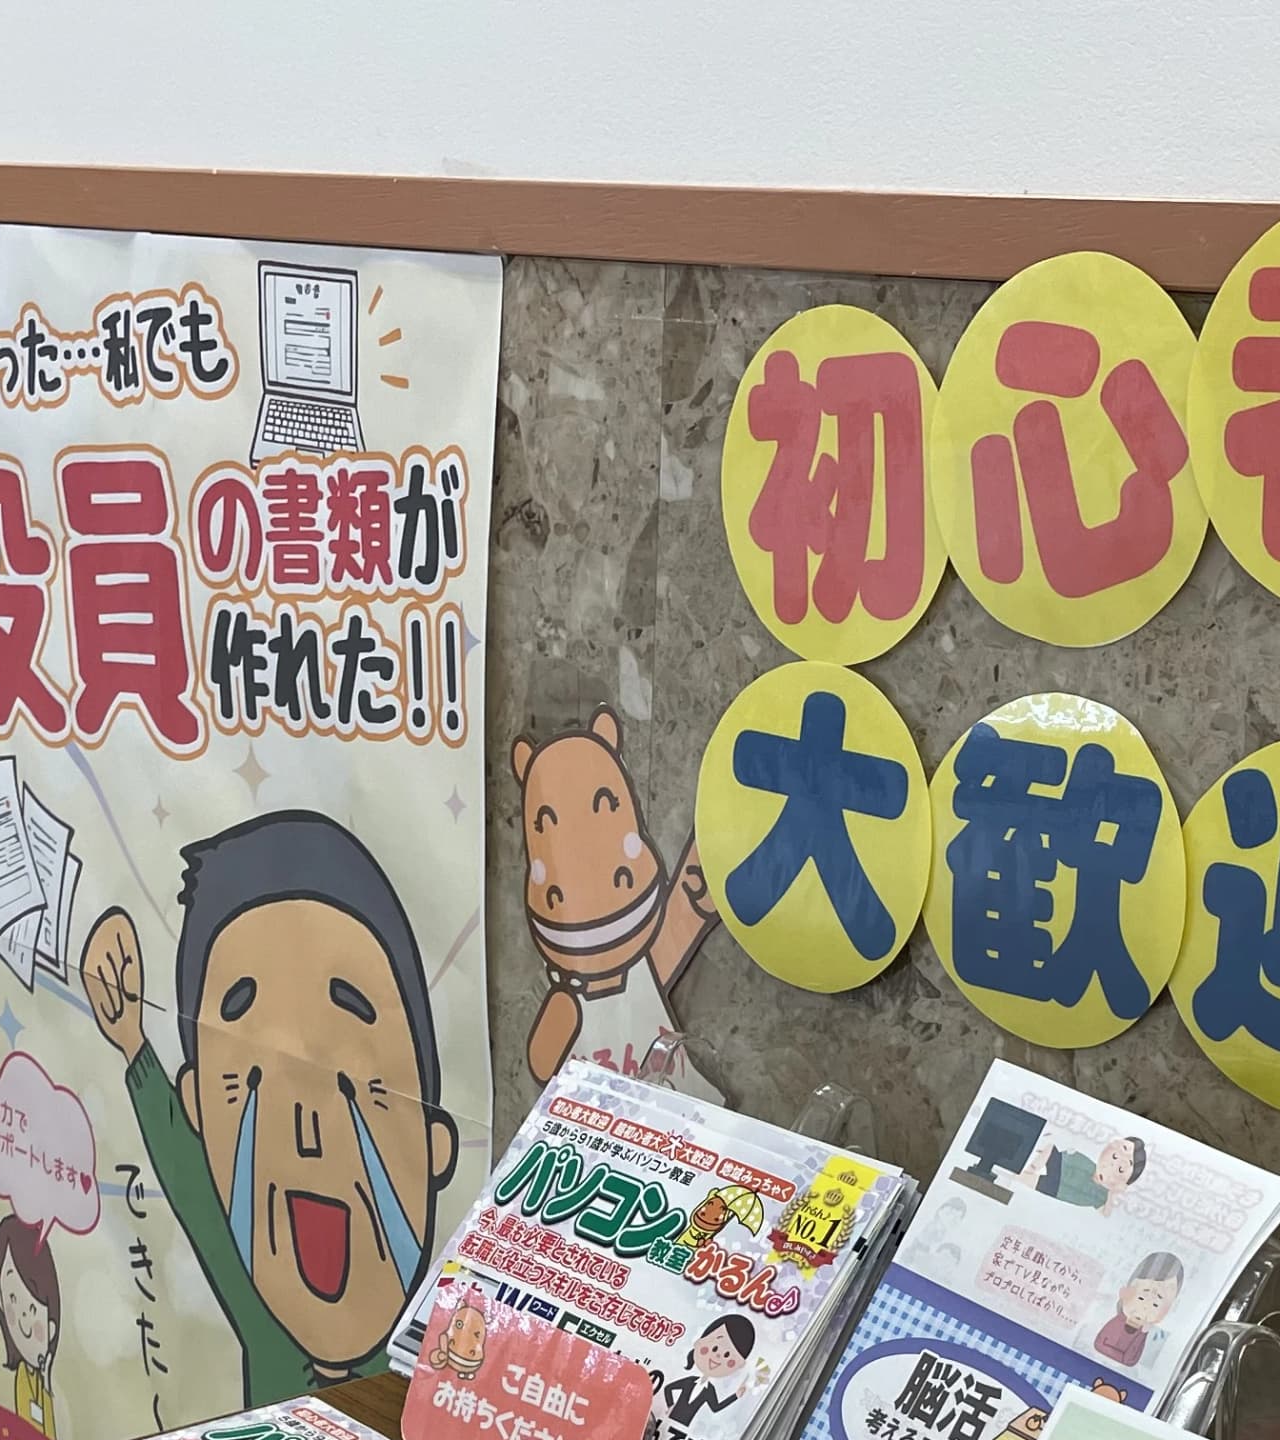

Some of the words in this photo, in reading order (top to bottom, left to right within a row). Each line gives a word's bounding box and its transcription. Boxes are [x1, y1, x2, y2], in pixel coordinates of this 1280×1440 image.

[496, 1144, 687, 1256] パソコン
[648, 1240, 691, 1274] 教室
[531, 1301, 558, 1317] ワード
[581, 1323, 614, 1344] エクセル
[502, 1364, 590, 1425] ご自由に
